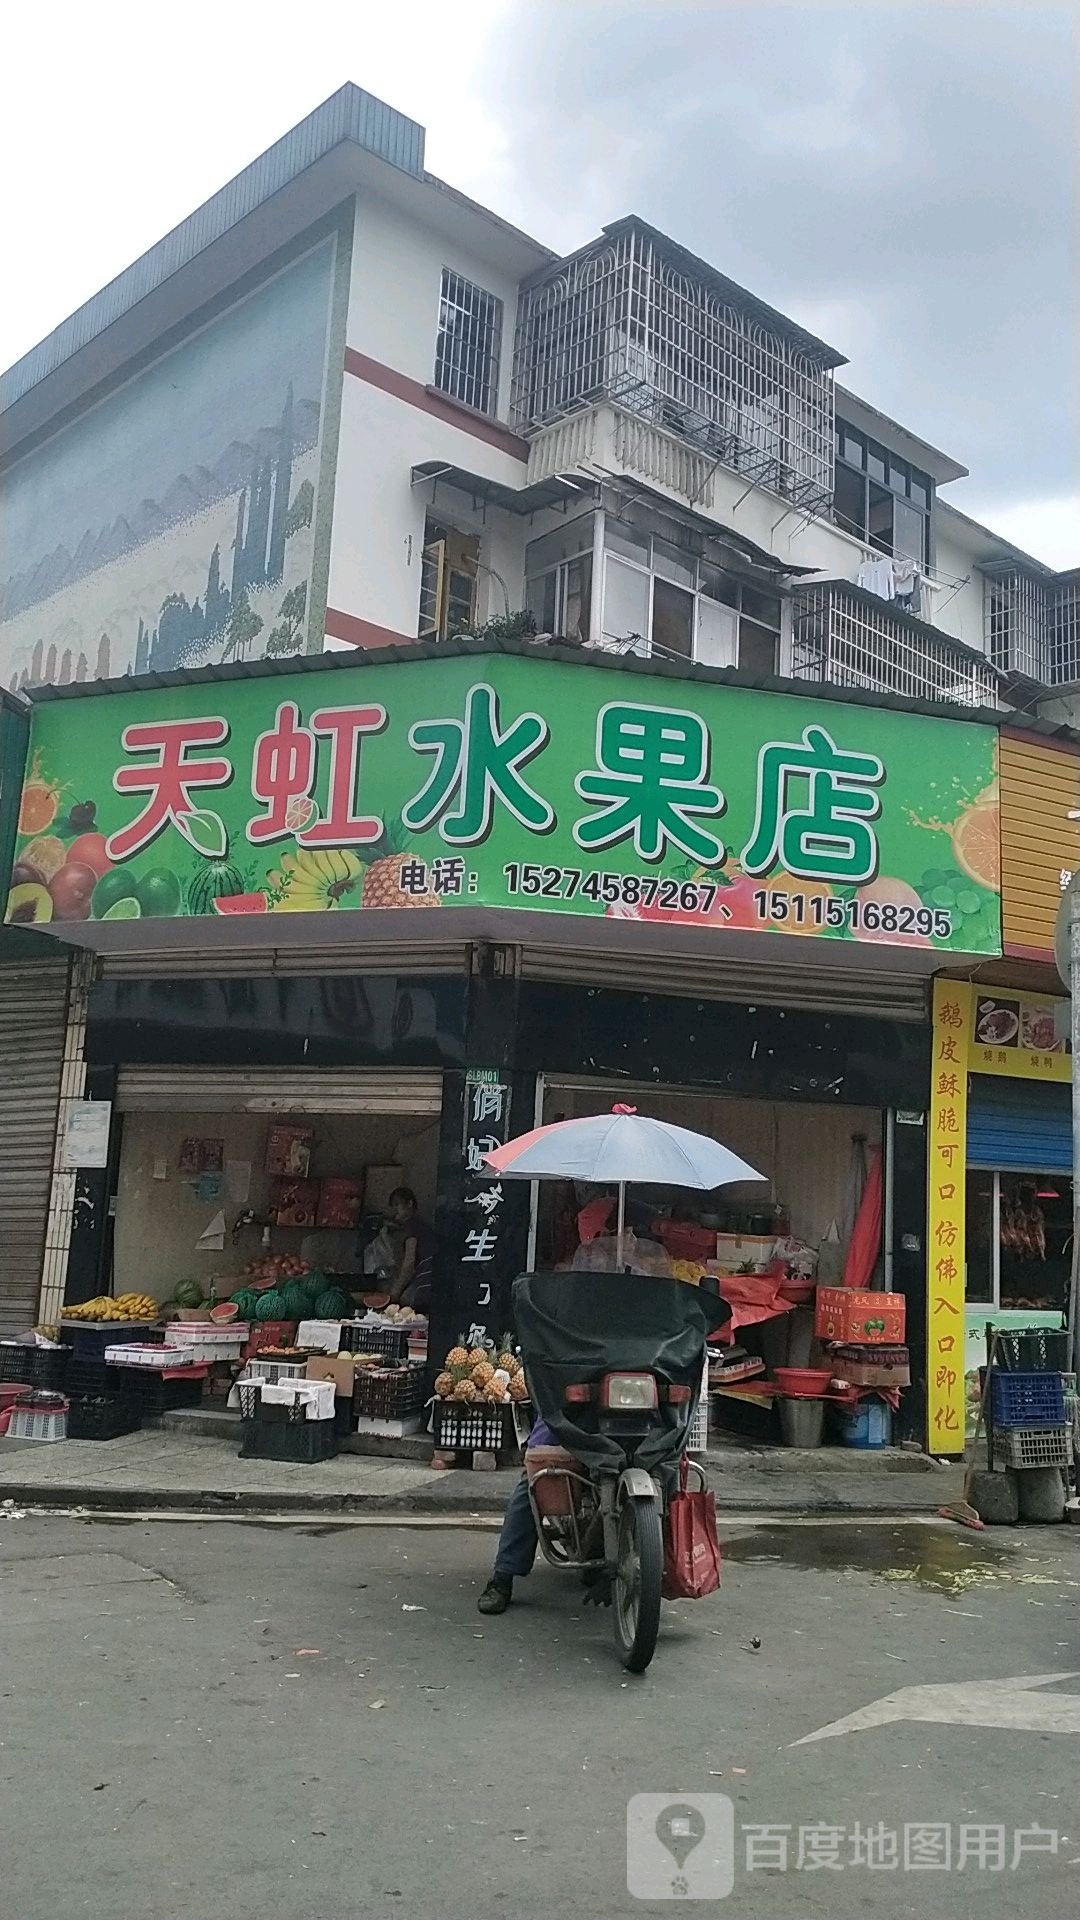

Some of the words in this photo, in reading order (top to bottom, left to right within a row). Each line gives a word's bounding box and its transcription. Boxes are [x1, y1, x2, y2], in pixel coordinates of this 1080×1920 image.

[104, 682, 884, 884] 天虹水果店
[753, 890, 953, 938] 15115168295
